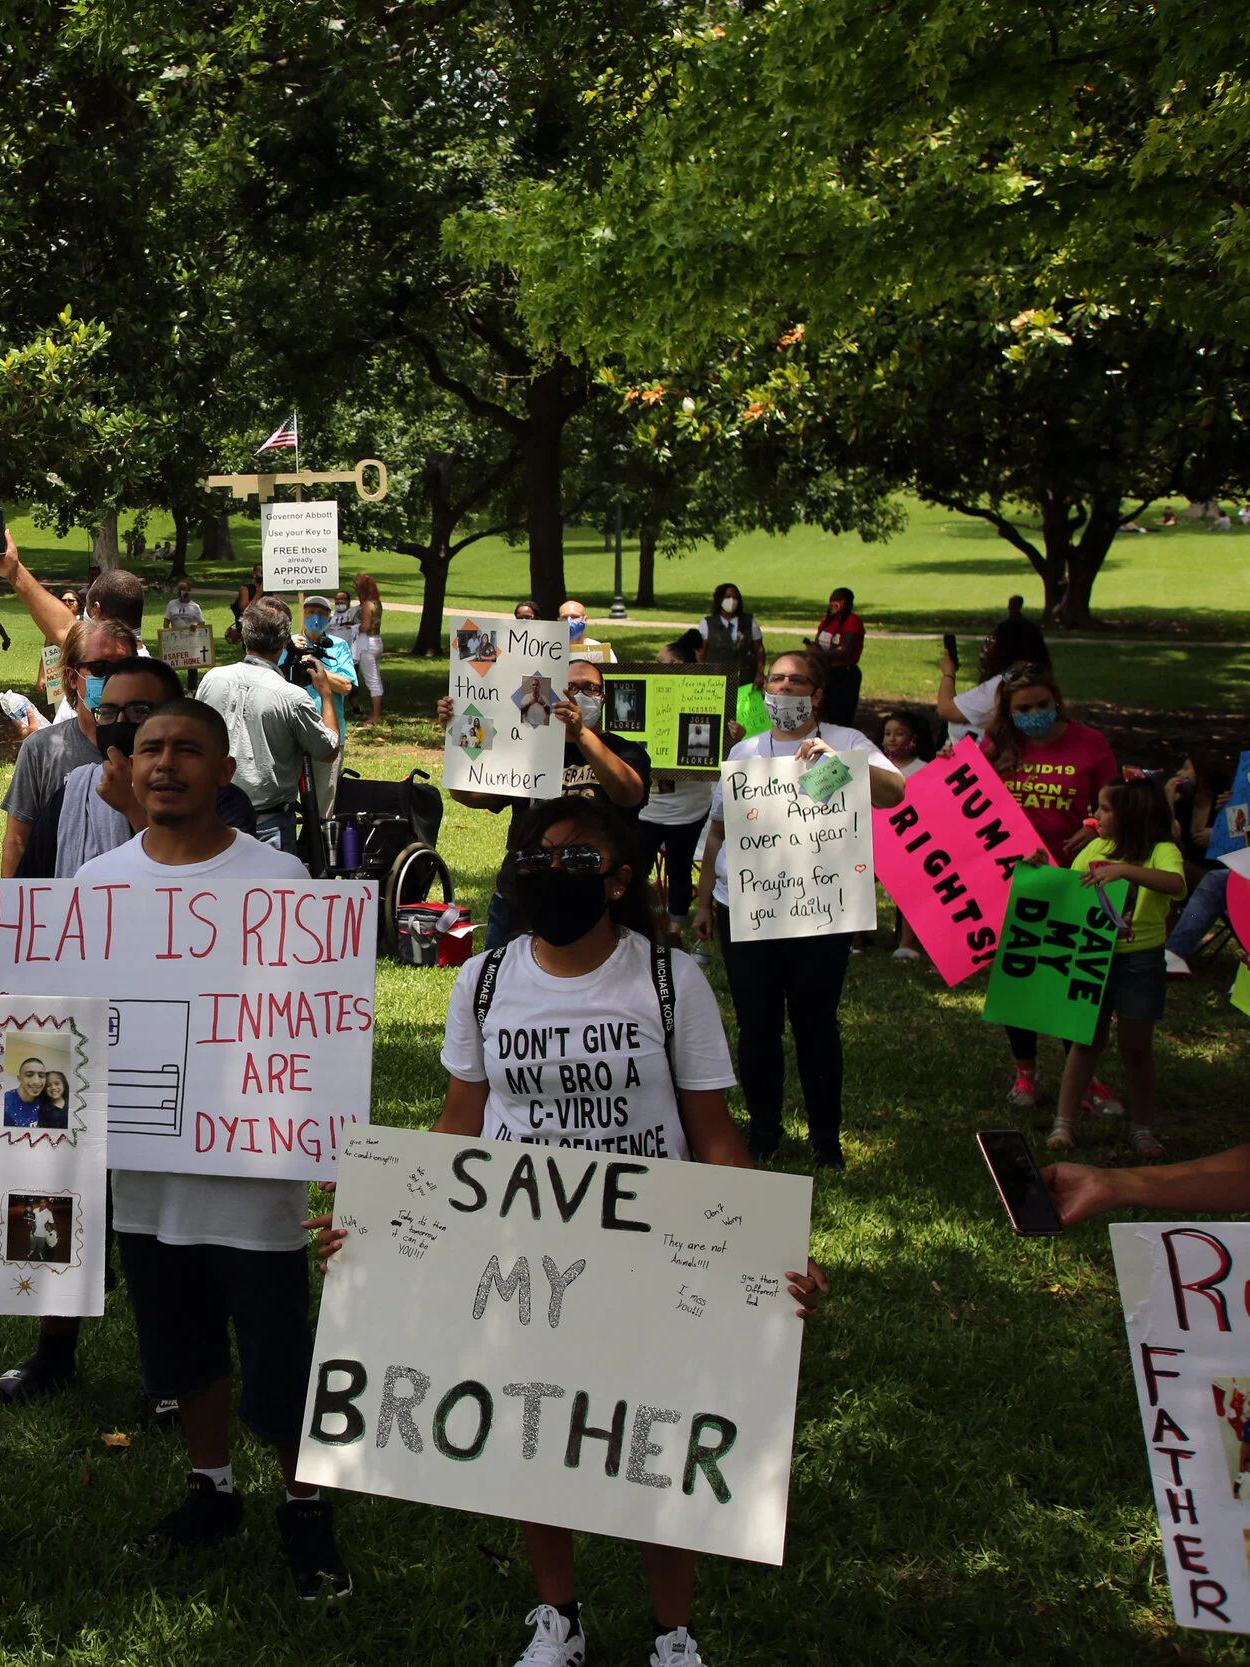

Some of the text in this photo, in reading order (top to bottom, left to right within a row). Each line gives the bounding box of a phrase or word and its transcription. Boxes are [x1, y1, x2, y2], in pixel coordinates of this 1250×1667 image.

[266, 512, 332, 520] Governor Abbott
[285, 530, 304, 538] your
[306, 528, 321, 537] Key
[322, 528, 332, 536] to
[273, 546, 328, 555] FREE those
[288, 556, 313, 564] already
[274, 566, 328, 575] APPROVED
[296, 576, 321, 586] parole
[508, 629, 562, 661] More
[454, 675, 500, 702] than
[510, 726, 522, 741] a
[656, 748, 668, 756] LIFE
[468, 763, 546, 790] Number
[727, 772, 798, 800] Pending
[1004, 781, 1062, 794] RISON
[788, 792, 848, 822] Appeal
[1013, 794, 1072, 810] EATH
[944, 763, 1024, 881] HUMA
[740, 834, 781, 850] over
[790, 834, 802, 846] a
[739, 866, 839, 900] Praying for
[889, 805, 998, 965] RIGHTS!
[155, 888, 218, 960] IS
[243, 886, 372, 966] RISIN'
[750, 908, 776, 930] you
[1002, 897, 1049, 978] DAD
[1038, 920, 1080, 976] MY
[1067, 906, 1118, 1006] SAVE
[478, 964, 496, 1027] MICHAEL KOR
[656, 959, 674, 1030] MICHAEL KORS
[196, 992, 372, 1044] INMATES
[498, 1022, 640, 1060] DON'T GIVE
[242, 1052, 312, 1094] ARE
[505, 1057, 640, 1094] MY BRO A
[530, 1096, 628, 1129] C-VIRUS
[450, 1148, 652, 1232] SAVE
[398, 1210, 414, 1224] Today
[403, 1234, 416, 1244] can
[419, 1239, 428, 1250] be
[664, 1234, 726, 1253] They are not
[472, 1254, 586, 1328] MY
[678, 1284, 689, 1296] I
[308, 1358, 738, 1504] BROTHER
[1140, 1342, 1230, 1624] FATHER
